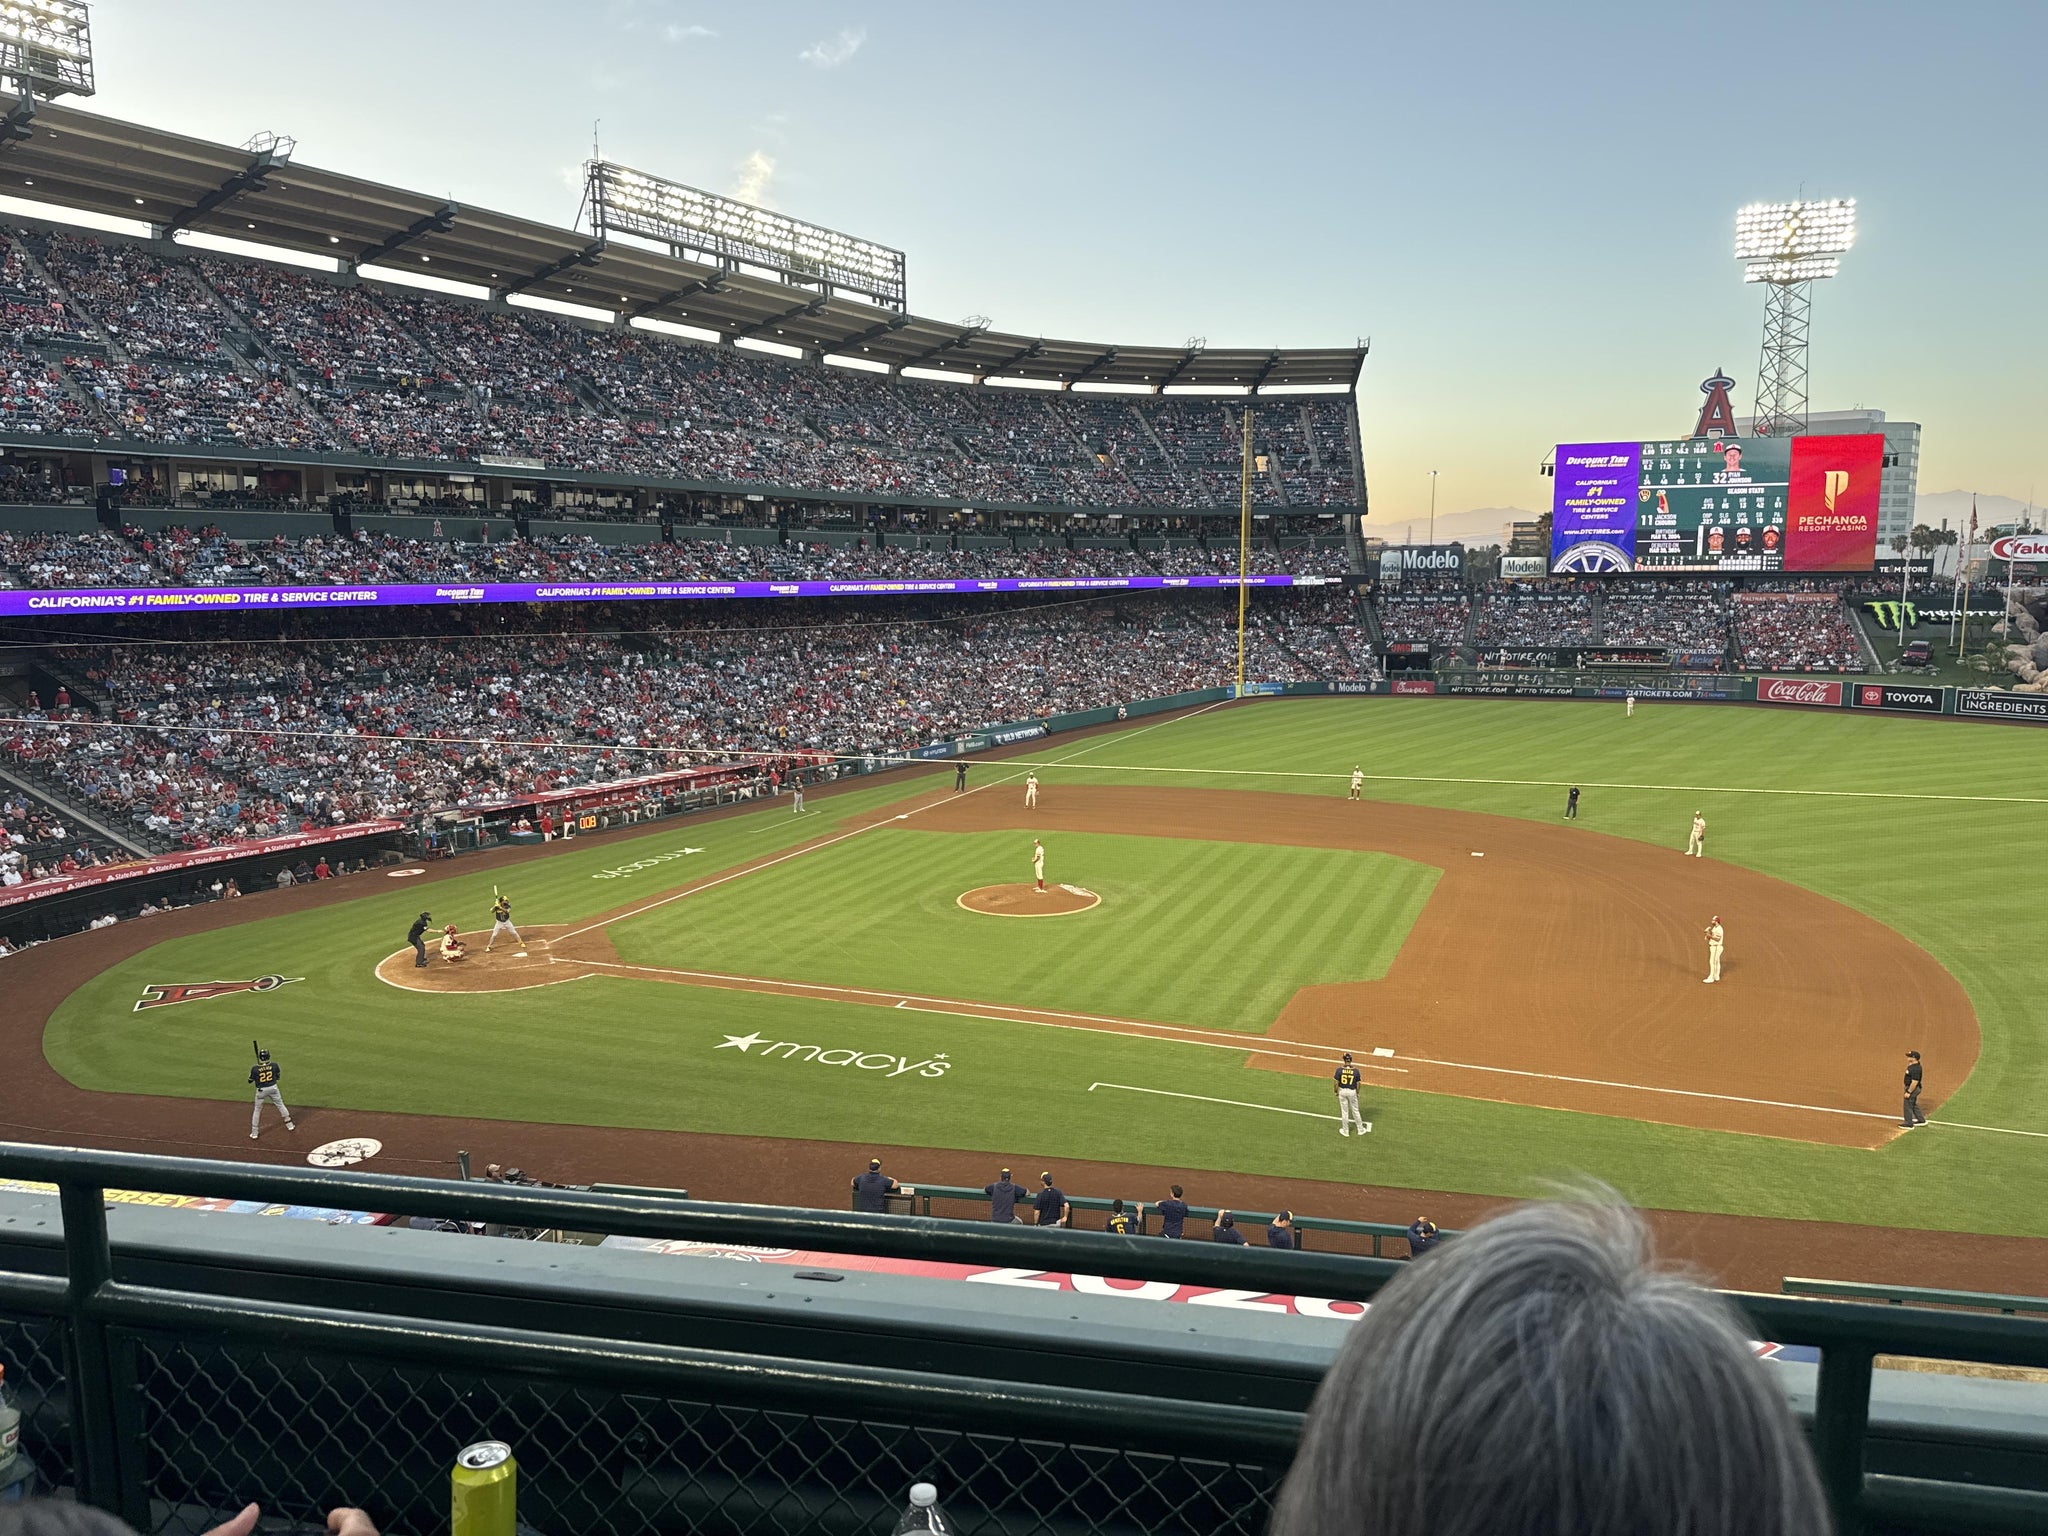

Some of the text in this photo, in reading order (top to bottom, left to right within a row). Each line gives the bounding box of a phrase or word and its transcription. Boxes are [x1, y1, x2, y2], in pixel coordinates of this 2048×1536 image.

[1713, 473, 1727, 484] 32
[1587, 487, 1603, 496] #1
[1565, 498, 1626, 506] FAMILY-OWNED
[1641, 515, 1653, 525] 11
[1799, 516, 1867, 525] PECHANGA
[1403, 550, 1459, 568] Modelo
[1507, 560, 1541, 572] Modelo
[536, 588, 591, 597] CALIFORNIA'S
[602, 587, 656, 596] FAMILY-OWNED
[657, 587, 672, 595] TIRE
[678, 586, 706, 594] SERVICE
[707, 586, 736, 594] CENTERS
[28, 591, 377, 608] CALIFORNIA'S #1 FAMILY-OWNED TIRE & SERVICE CENTERS
[1339, 683, 1366, 692] Modelo
[1886, 692, 1933, 704] TOYOTA
[1966, 692, 1992, 700] JUST
[1966, 700, 2047, 714] INGREDIENTS
[1015, 728, 1039, 740] NETWORK
[259, 1071, 273, 1083] 22
[1341, 1074, 1354, 1085] 67
[103, 1188, 194, 1208] ERSEY
